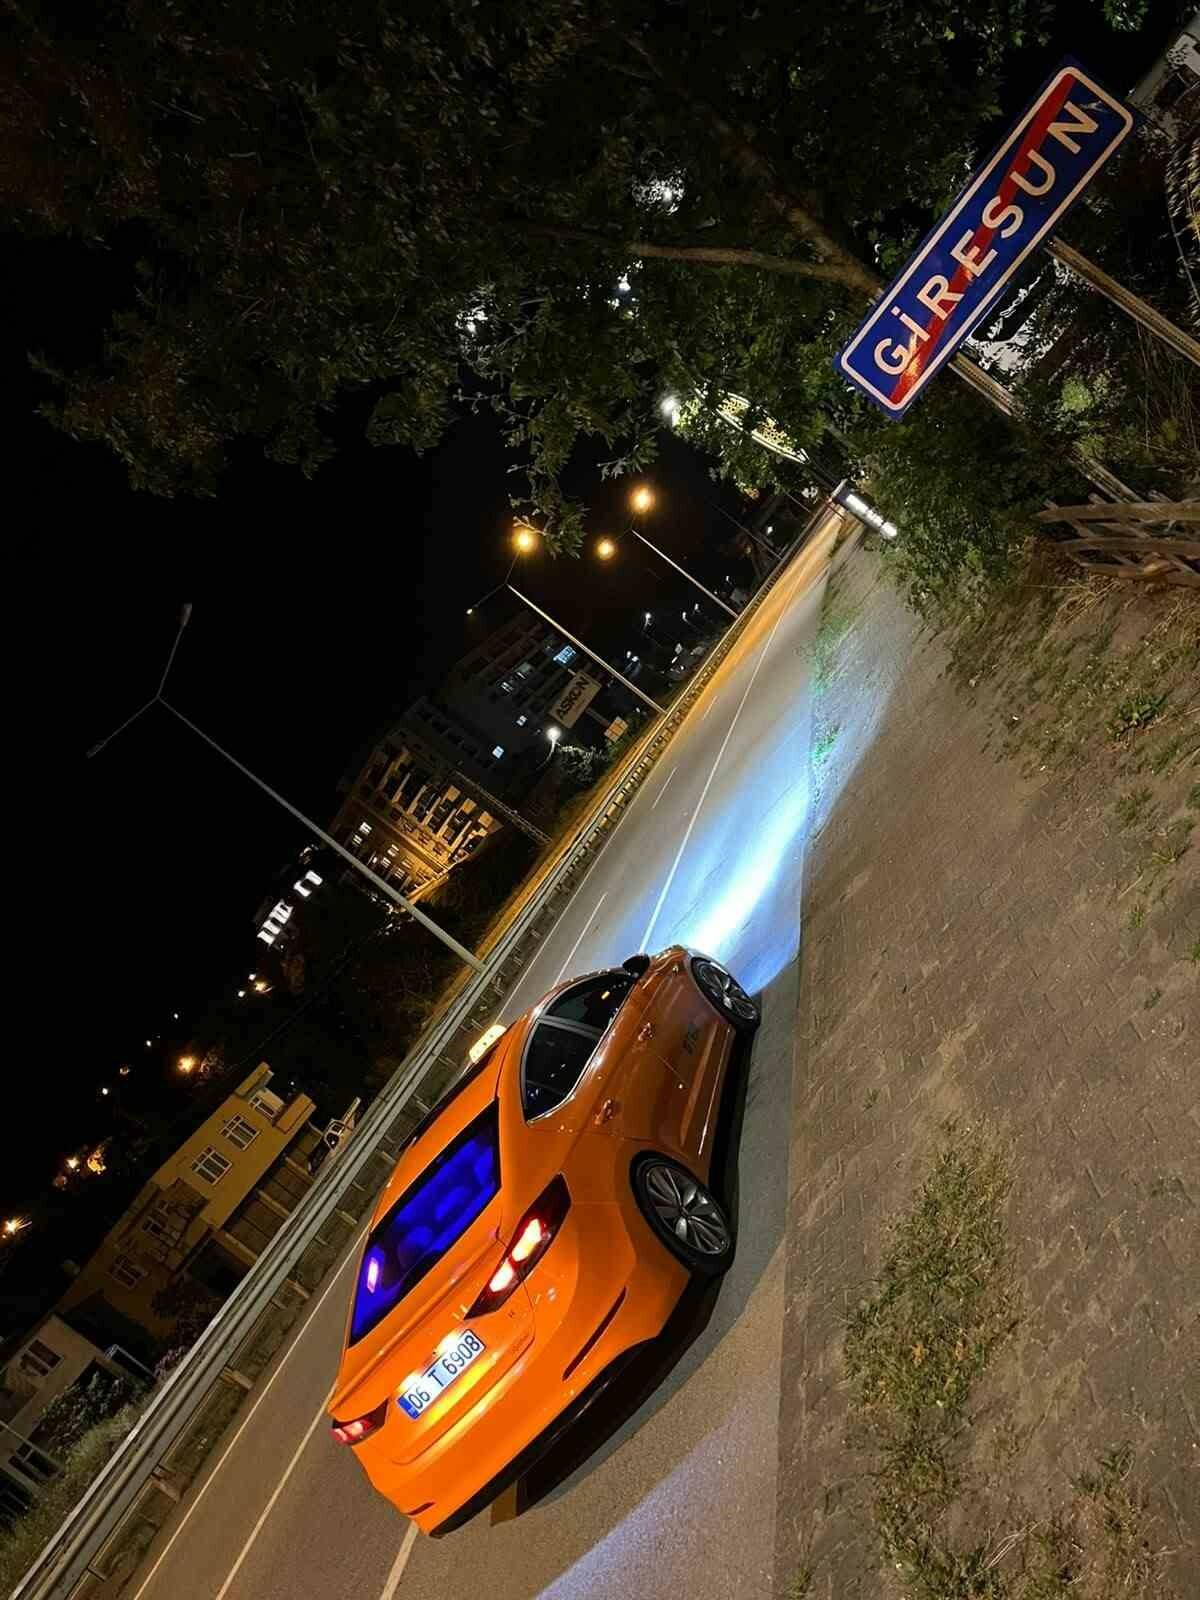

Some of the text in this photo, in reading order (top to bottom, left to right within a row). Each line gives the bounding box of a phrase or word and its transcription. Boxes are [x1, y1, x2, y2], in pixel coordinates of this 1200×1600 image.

[408, 1335, 481, 1409] 06 T 6908
